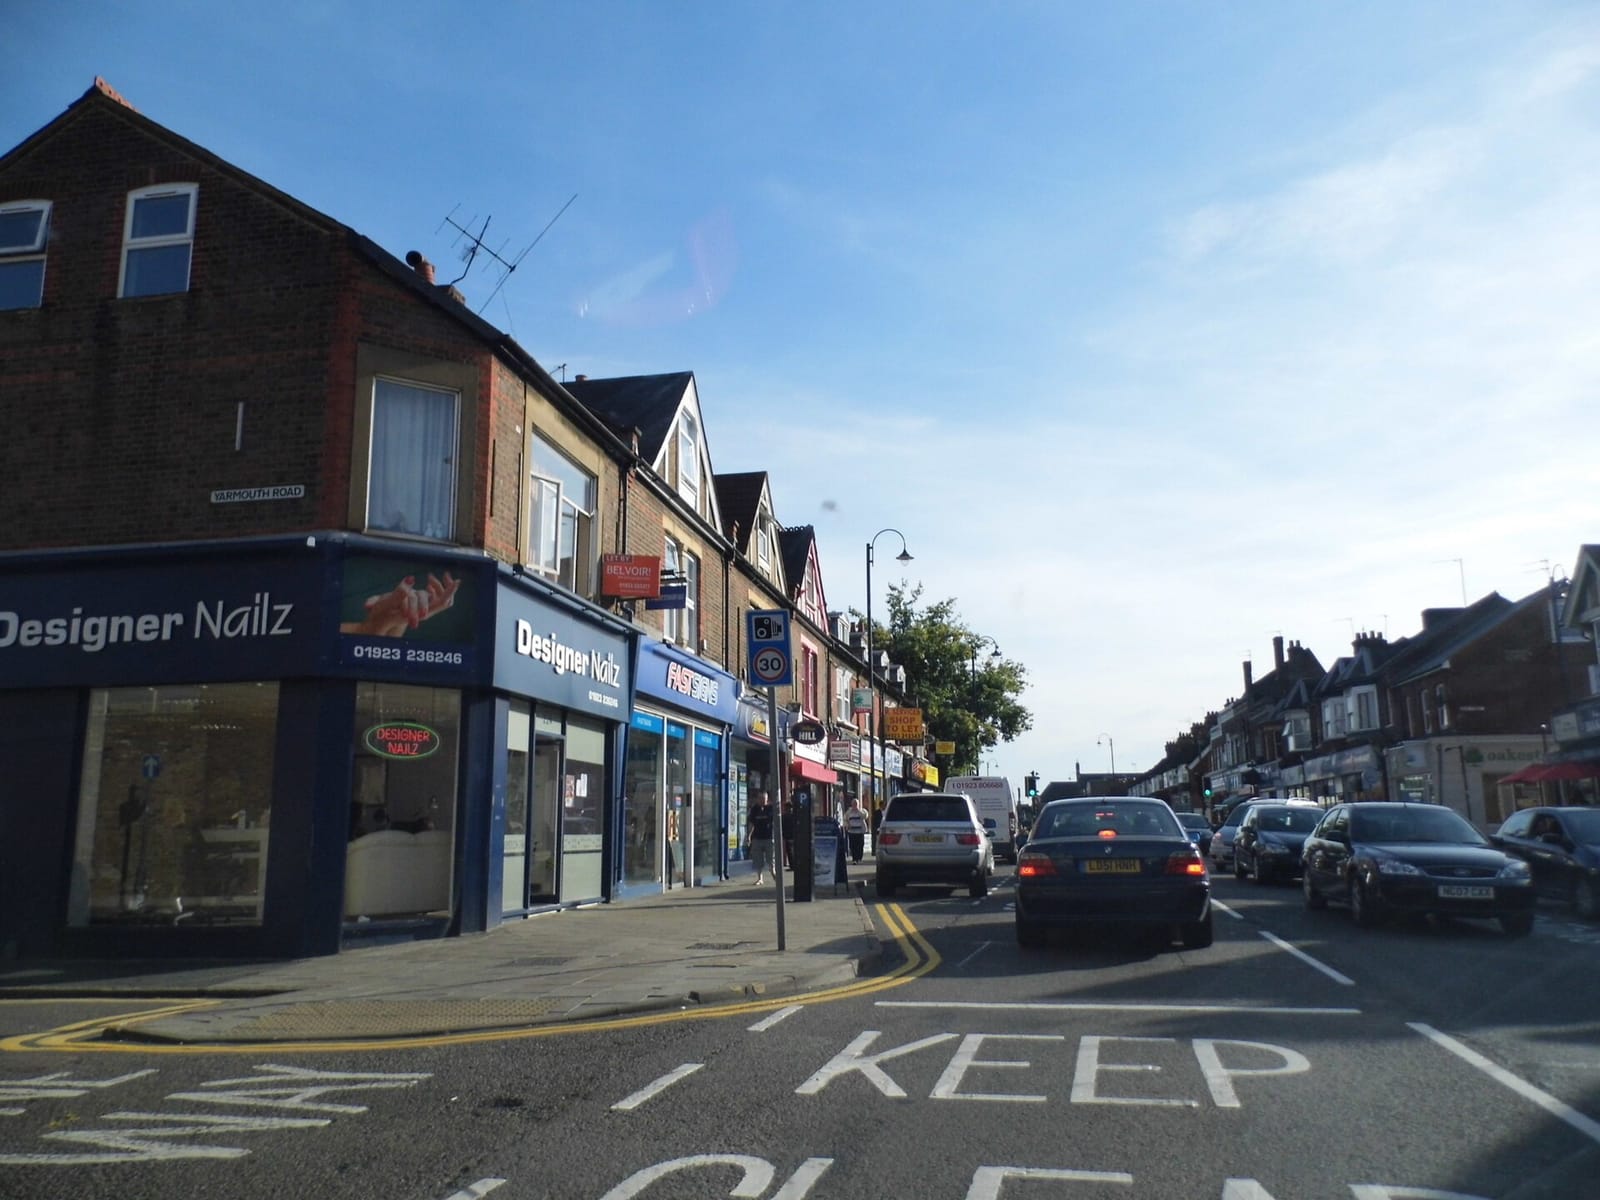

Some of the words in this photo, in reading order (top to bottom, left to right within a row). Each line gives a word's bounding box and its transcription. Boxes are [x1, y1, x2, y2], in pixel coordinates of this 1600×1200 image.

[215, 489, 270, 501] YARMOUTH
[272, 486, 302, 498] ROAD
[0, 607, 184, 652] Designer
[194, 592, 293, 639] Nailz
[354, 645, 401, 660] 01923
[406, 649, 462, 664] 236246
[517, 618, 589, 675] Designer
[591, 649, 620, 688] Nailz
[759, 657, 781, 672] 30
[889, 716, 915, 724] SHOP
[377, 727, 430, 742] DESIGNER
[798, 731, 817, 740] HILL
[902, 725, 919, 733] LET
[388, 741, 419, 755] NAILZ
[794, 1029, 1311, 1108] KEEP
